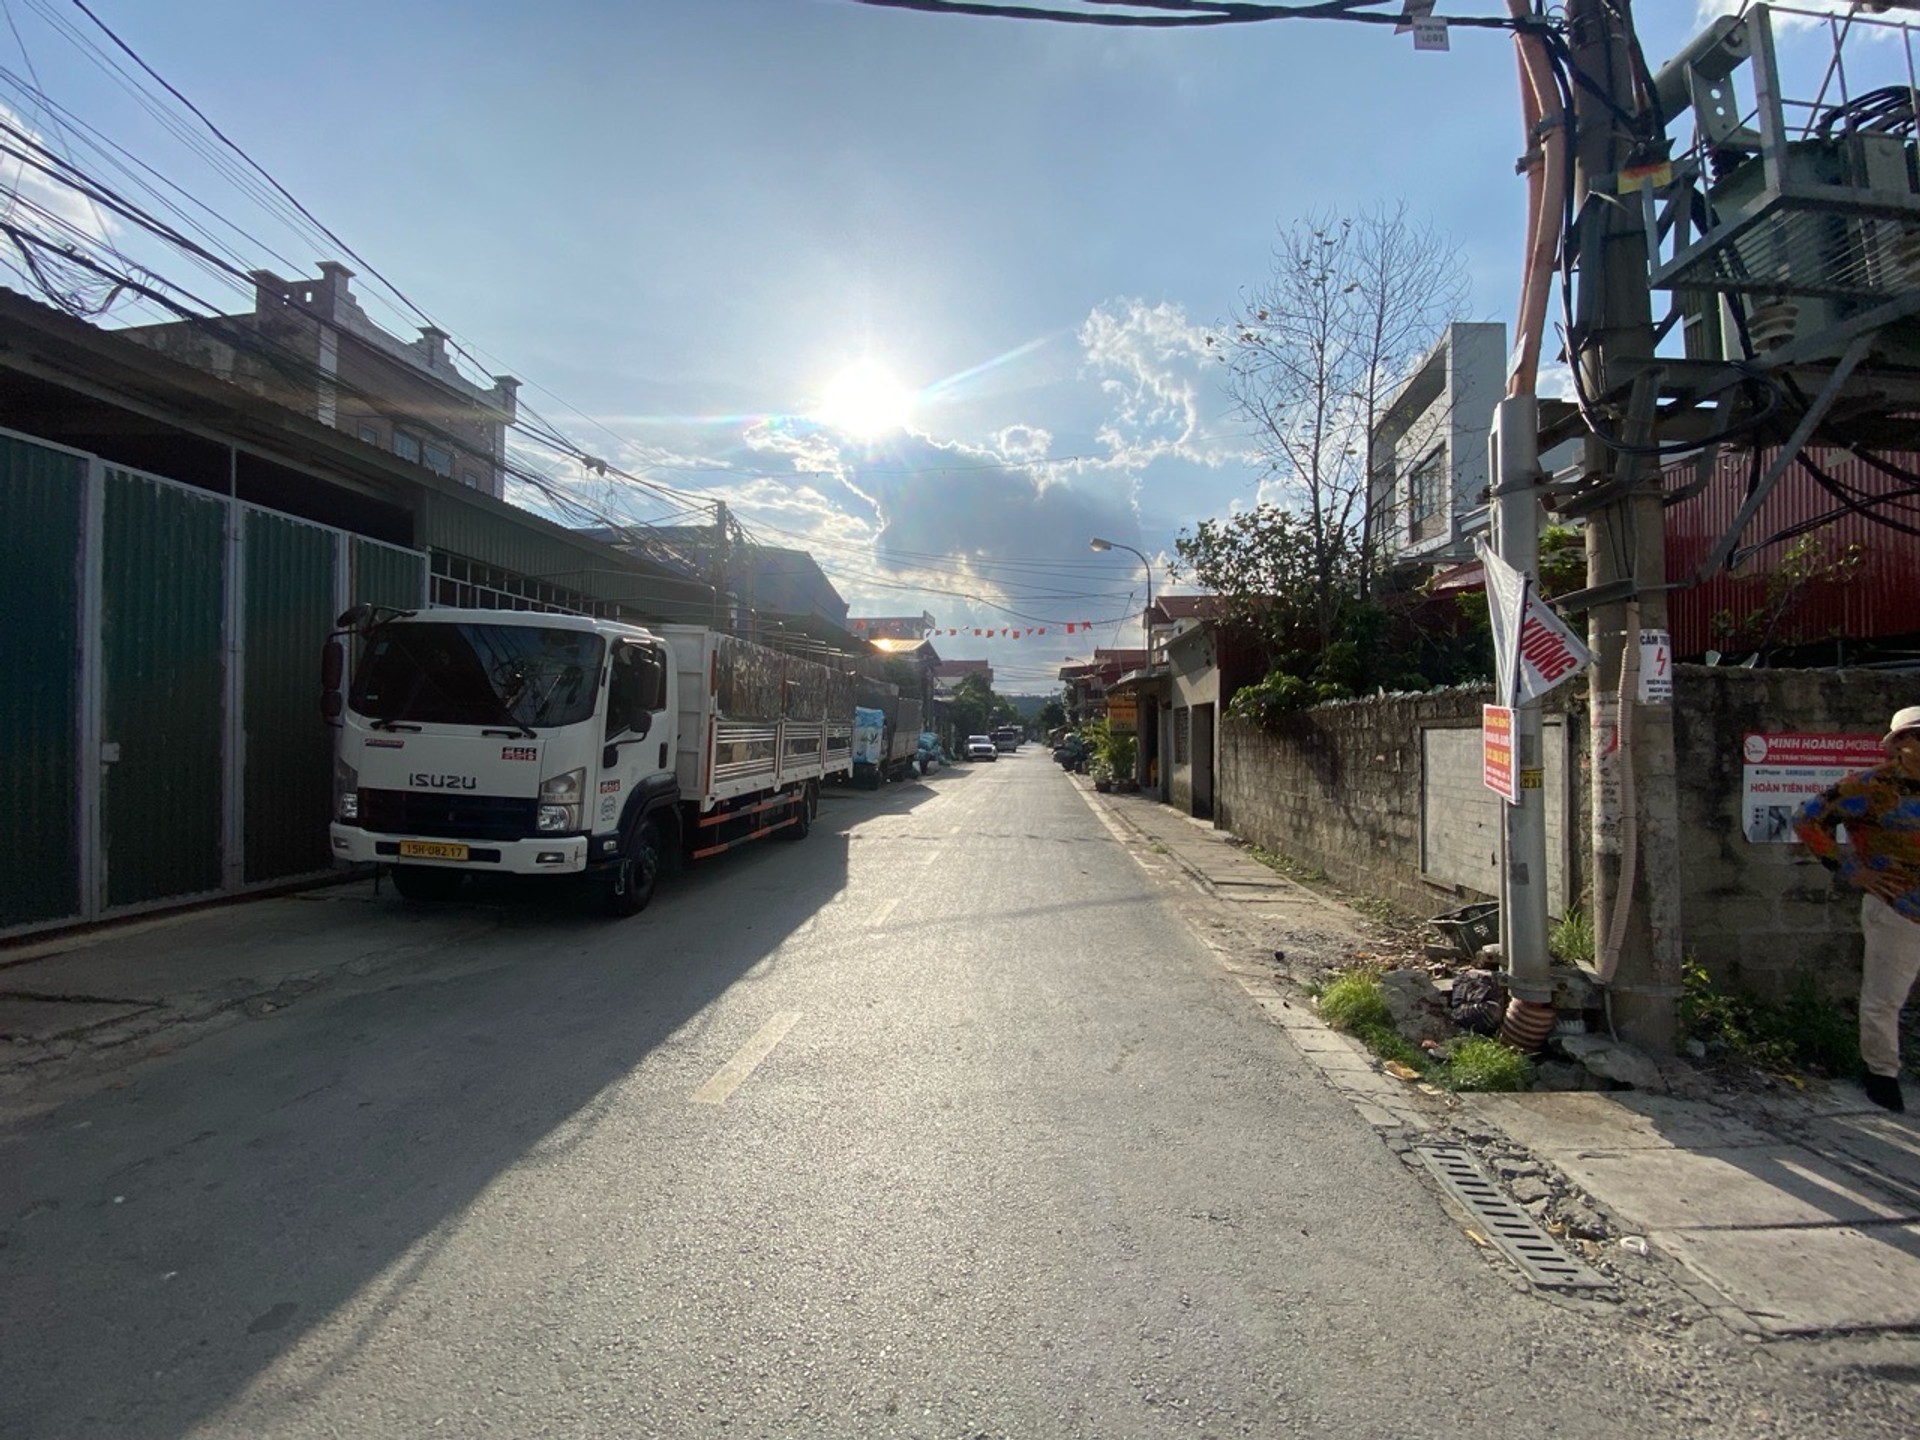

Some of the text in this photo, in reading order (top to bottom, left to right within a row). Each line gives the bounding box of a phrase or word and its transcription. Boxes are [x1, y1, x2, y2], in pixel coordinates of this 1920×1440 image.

[1768, 738, 1885, 751] MINH HOÀNG MOBILE
[409, 773, 477, 790] ISUZU
[1750, 782, 1780, 793] HOÀN
